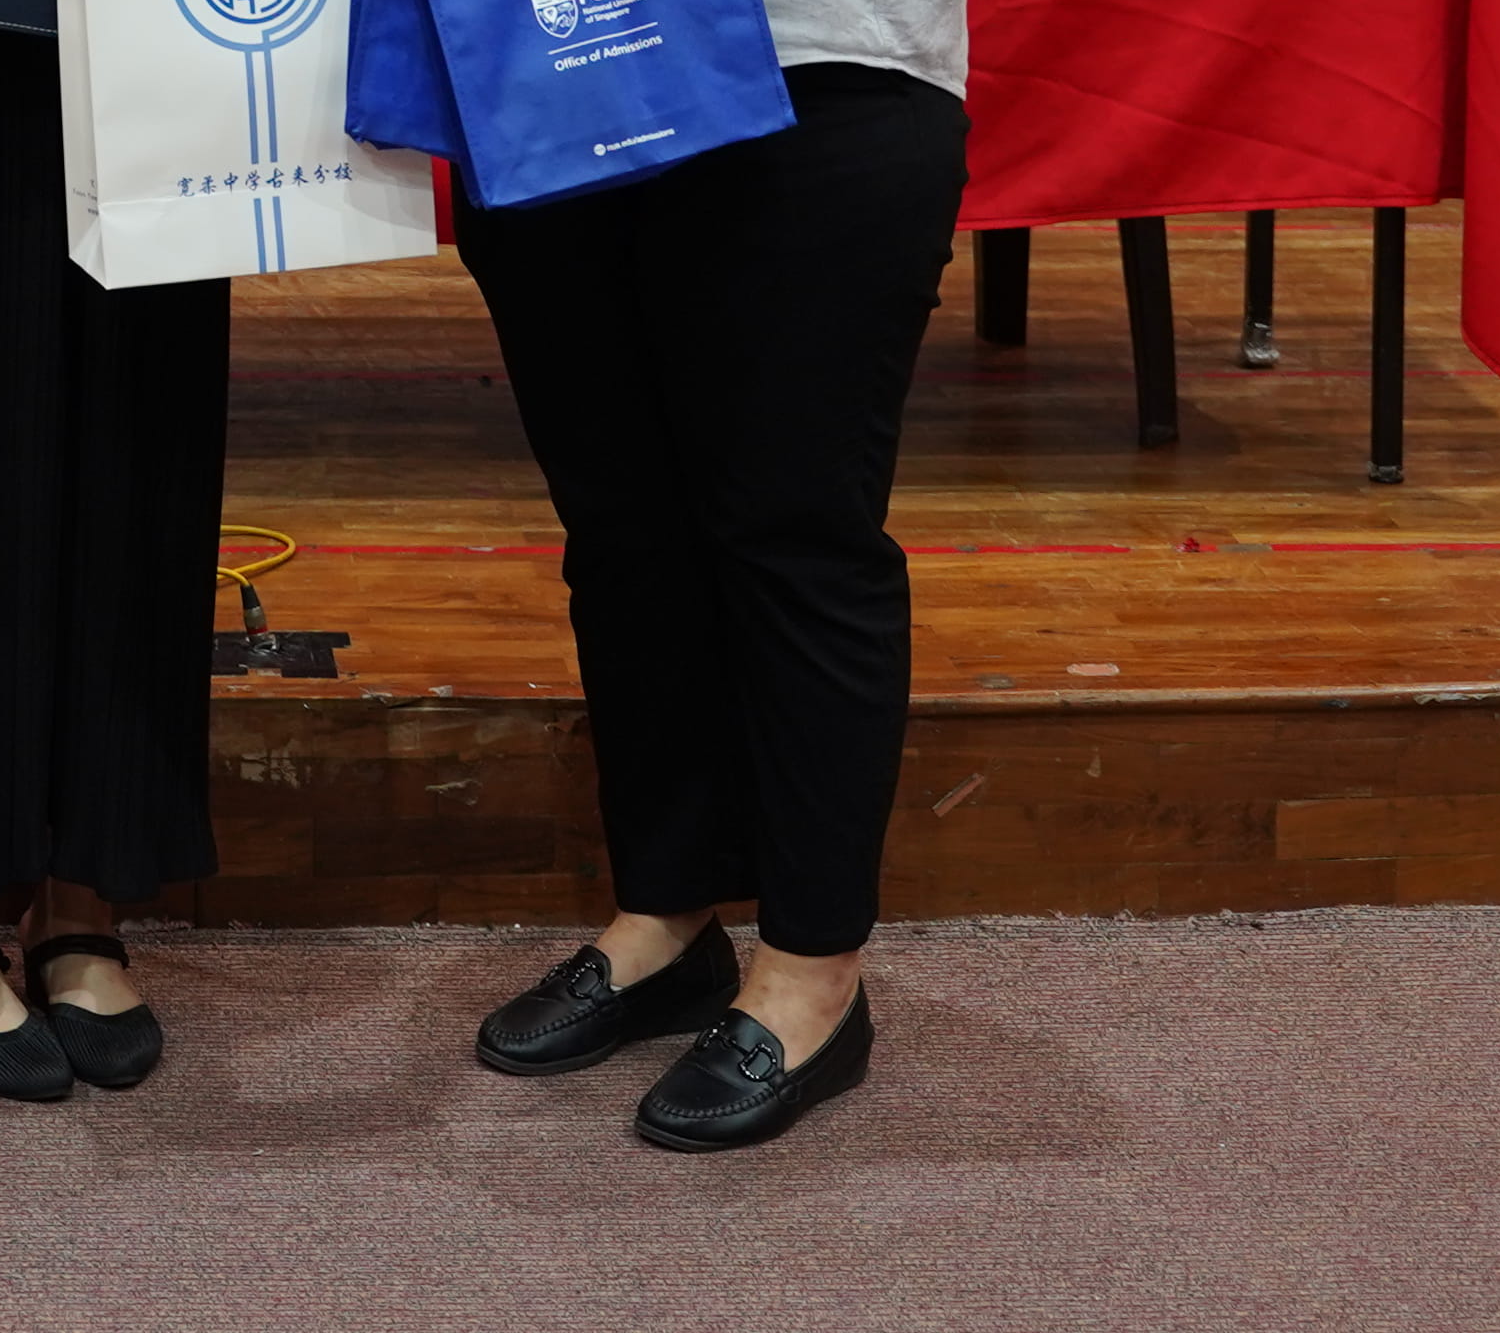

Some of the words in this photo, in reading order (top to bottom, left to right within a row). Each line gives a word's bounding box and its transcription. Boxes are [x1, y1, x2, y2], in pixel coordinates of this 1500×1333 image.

[582, 0, 613, 15] National
[594, 7, 631, 22] Singapore
[554, 55, 588, 72] Office
[589, 48, 601, 62] of
[603, 35, 664, 59] Admissions
